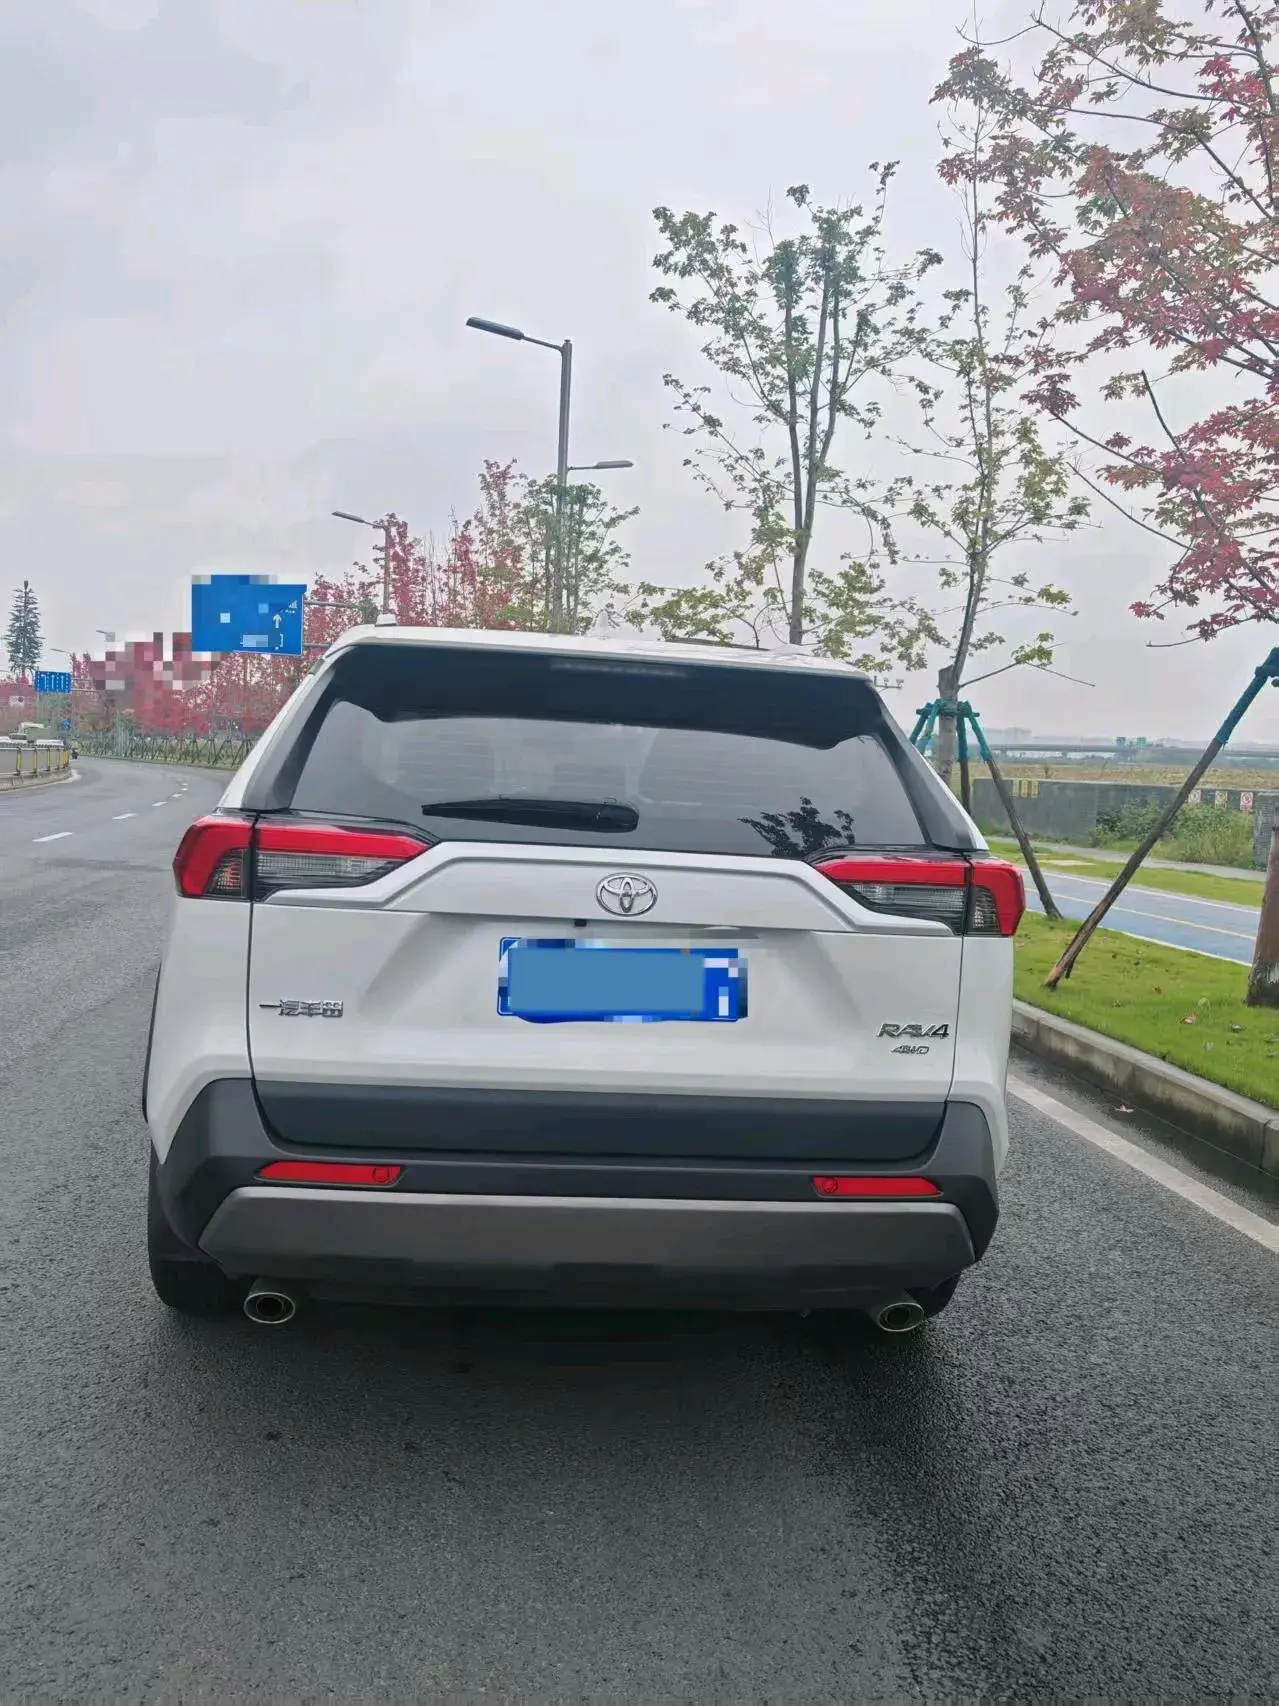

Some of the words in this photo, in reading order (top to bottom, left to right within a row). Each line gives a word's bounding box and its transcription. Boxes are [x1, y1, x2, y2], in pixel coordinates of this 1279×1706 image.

[258, 997, 343, 1018] 一汽丰田
[876, 1023, 949, 1039] RAV4
[891, 1044, 930, 1055] 4WD
